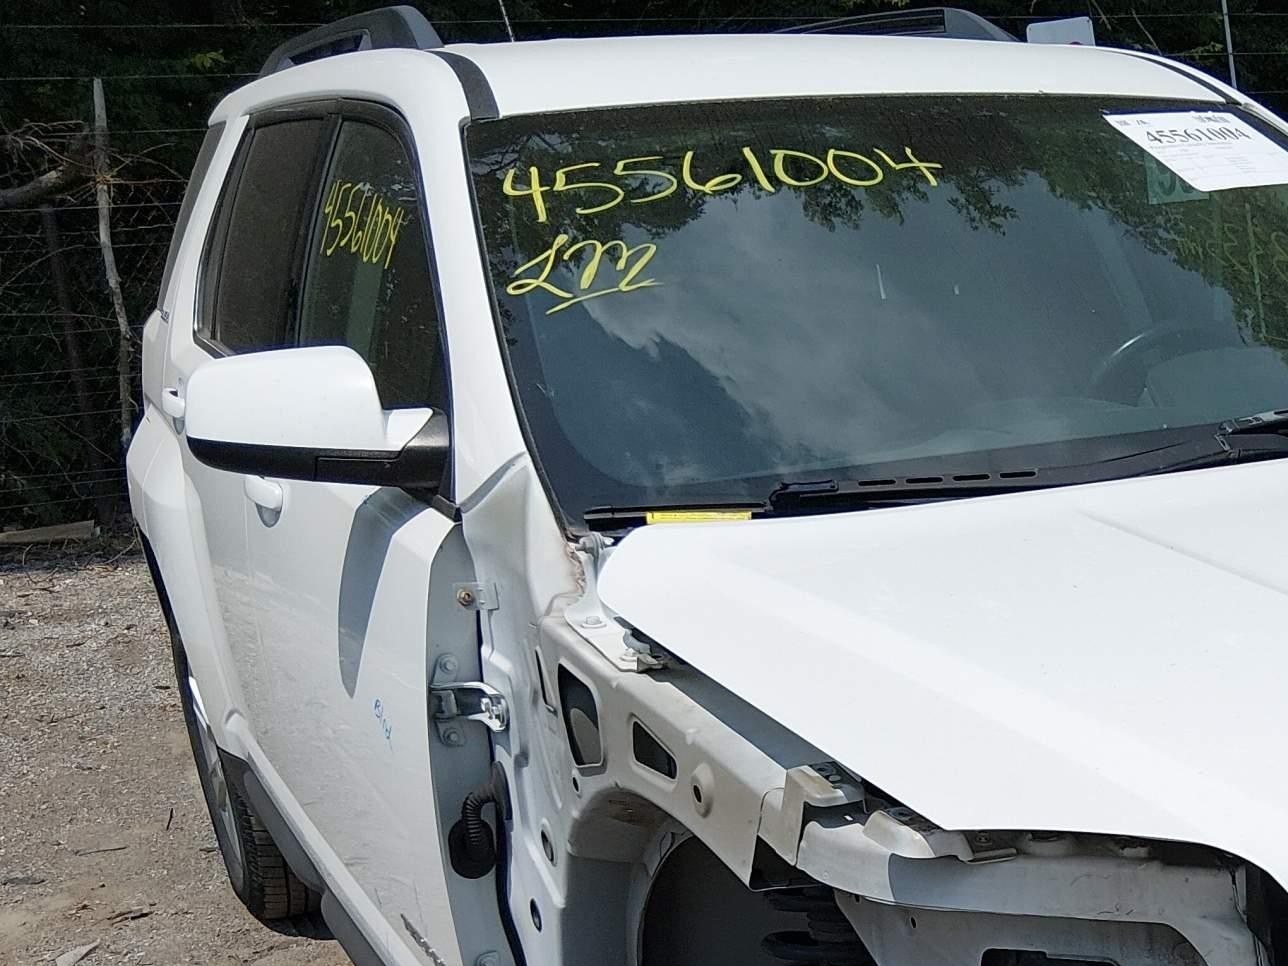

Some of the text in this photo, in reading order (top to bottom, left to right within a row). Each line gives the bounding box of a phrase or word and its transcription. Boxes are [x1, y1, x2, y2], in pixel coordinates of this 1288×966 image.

[1146, 127, 1252, 144] 45561004
[502, 146, 943, 224] 45561004
[319, 179, 405, 270] 45561004
